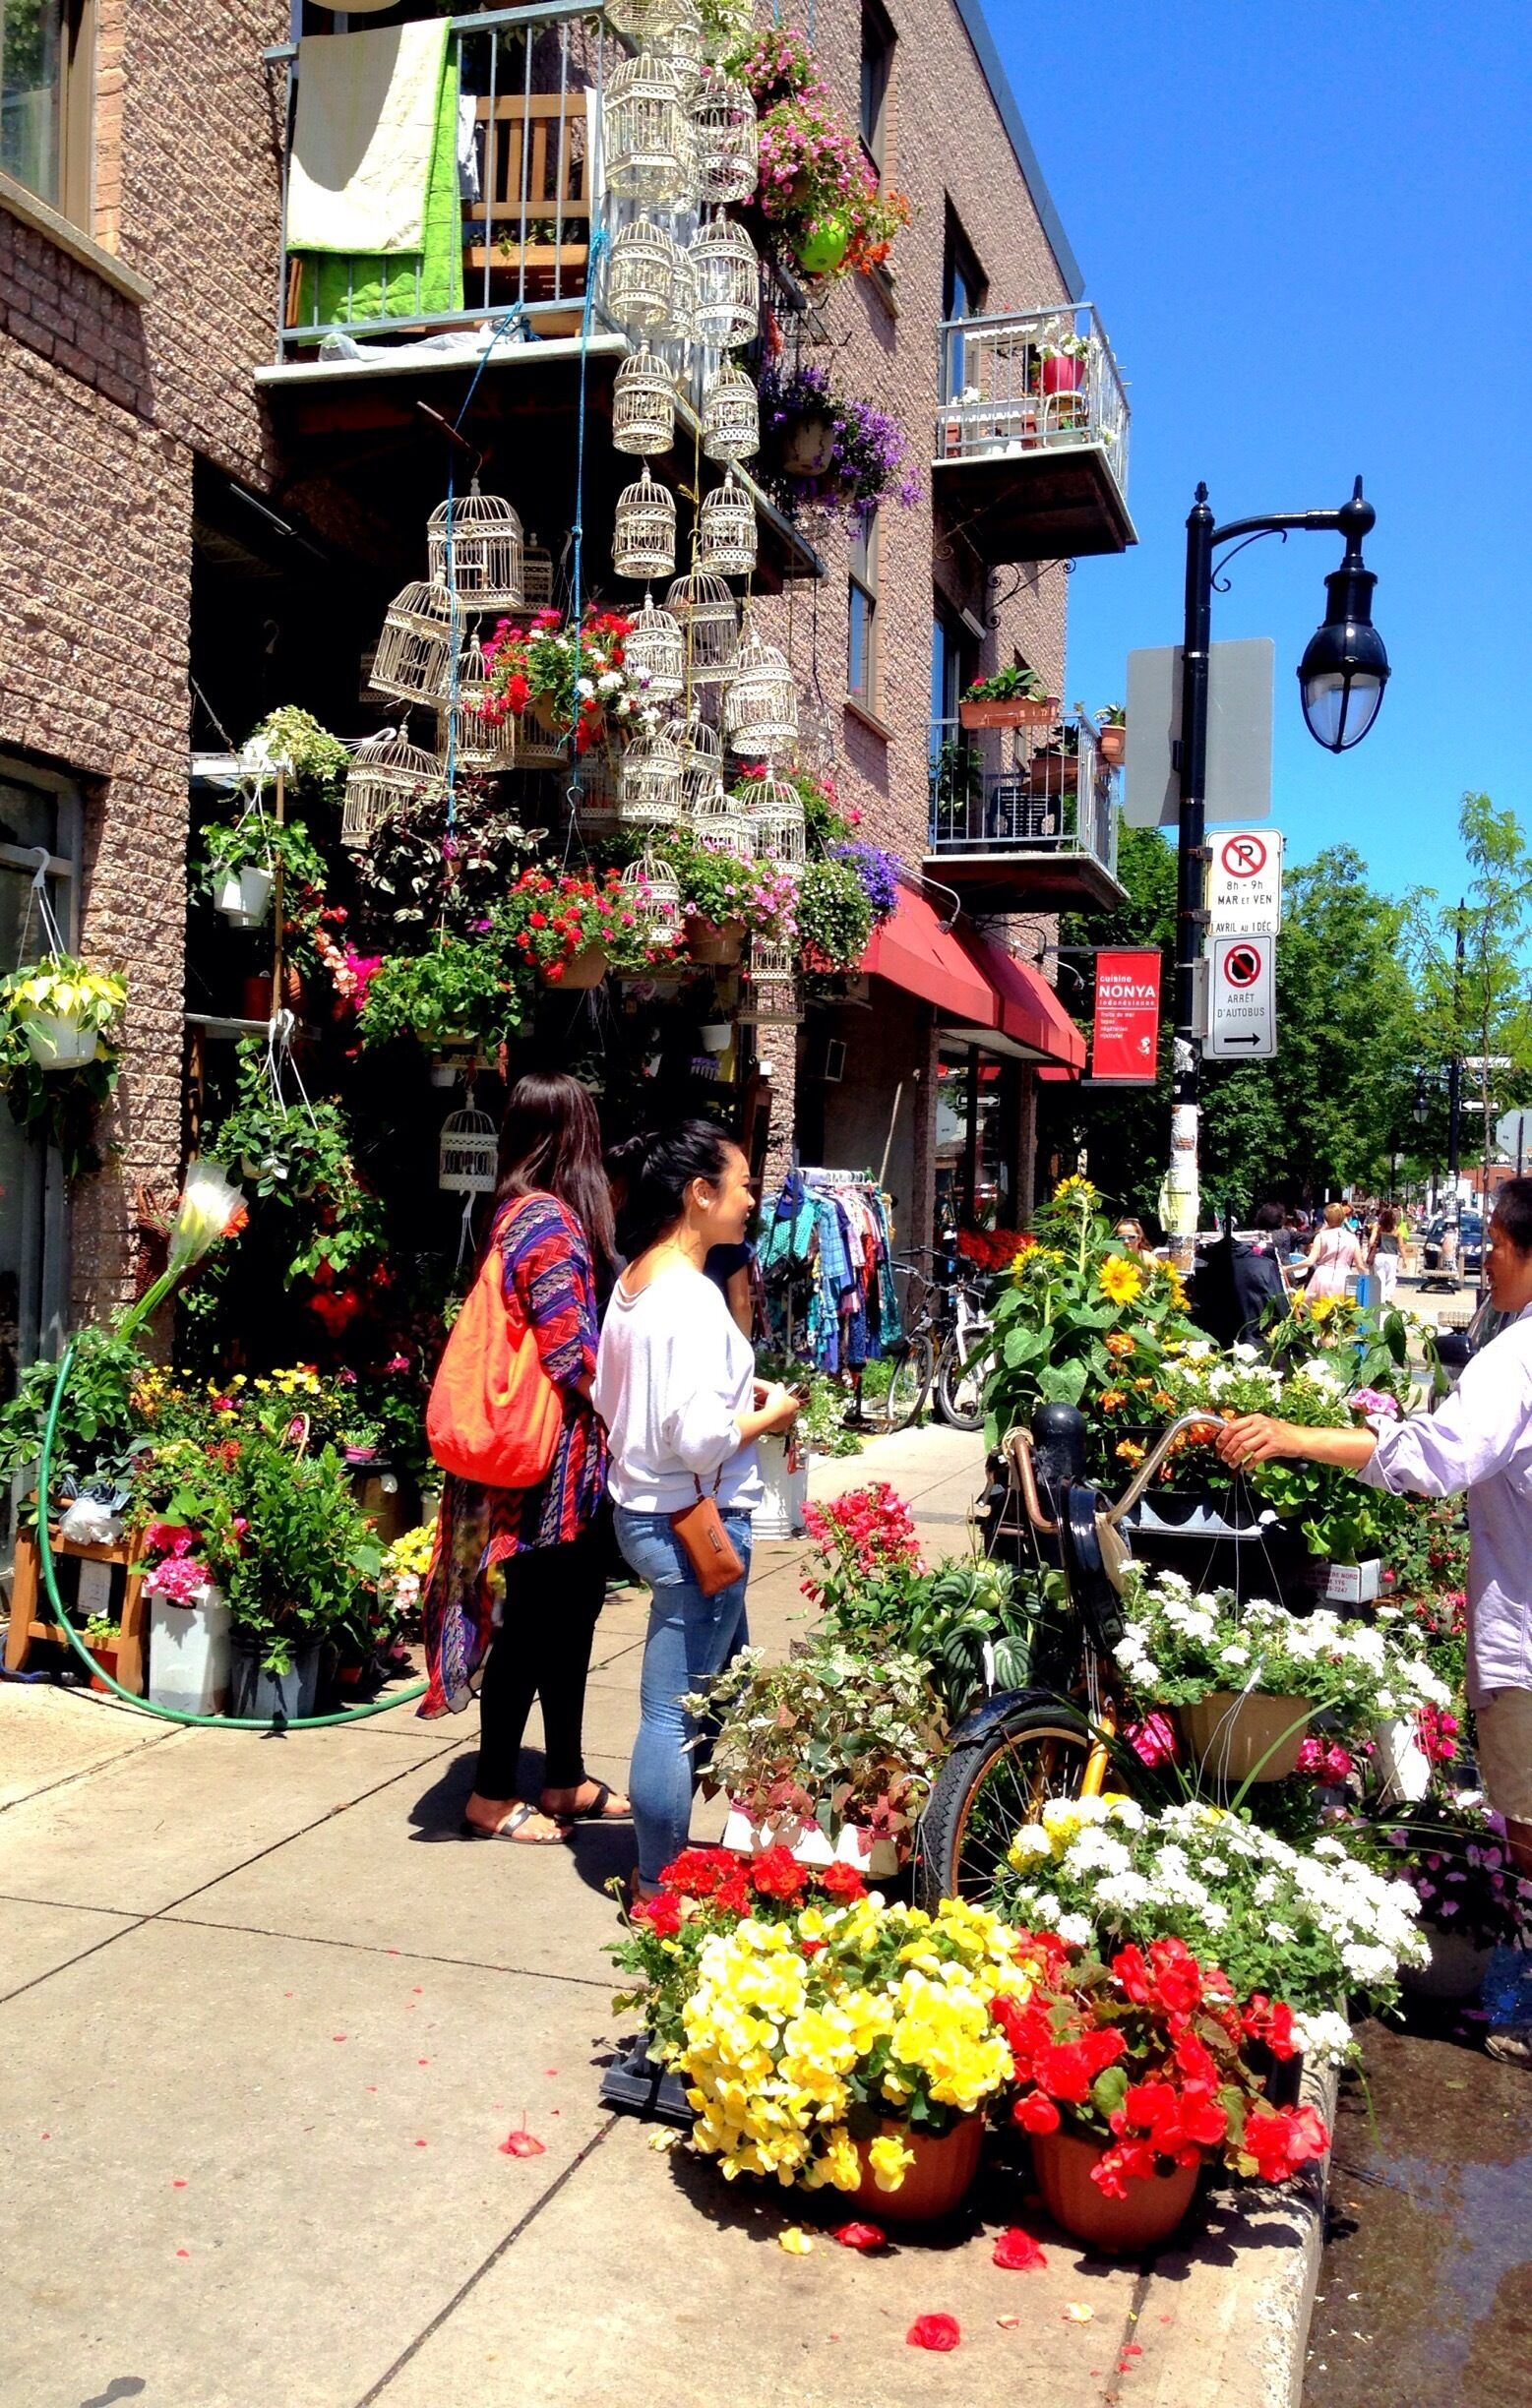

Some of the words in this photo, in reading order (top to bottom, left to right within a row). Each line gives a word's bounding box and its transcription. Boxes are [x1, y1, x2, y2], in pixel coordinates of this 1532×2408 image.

[1226, 880, 1239, 890] 8h
[1251, 879, 1263, 889] 9h
[1217, 895, 1238, 905] MAR
[1253, 894, 1272, 904] VEN
[1215, 923, 1237, 933] AVRIL
[1099, 985, 1156, 998] NONYA
[1227, 992, 1255, 1003] ARRÊT
[1217, 1007, 1265, 1018] D'AUTOBUS
